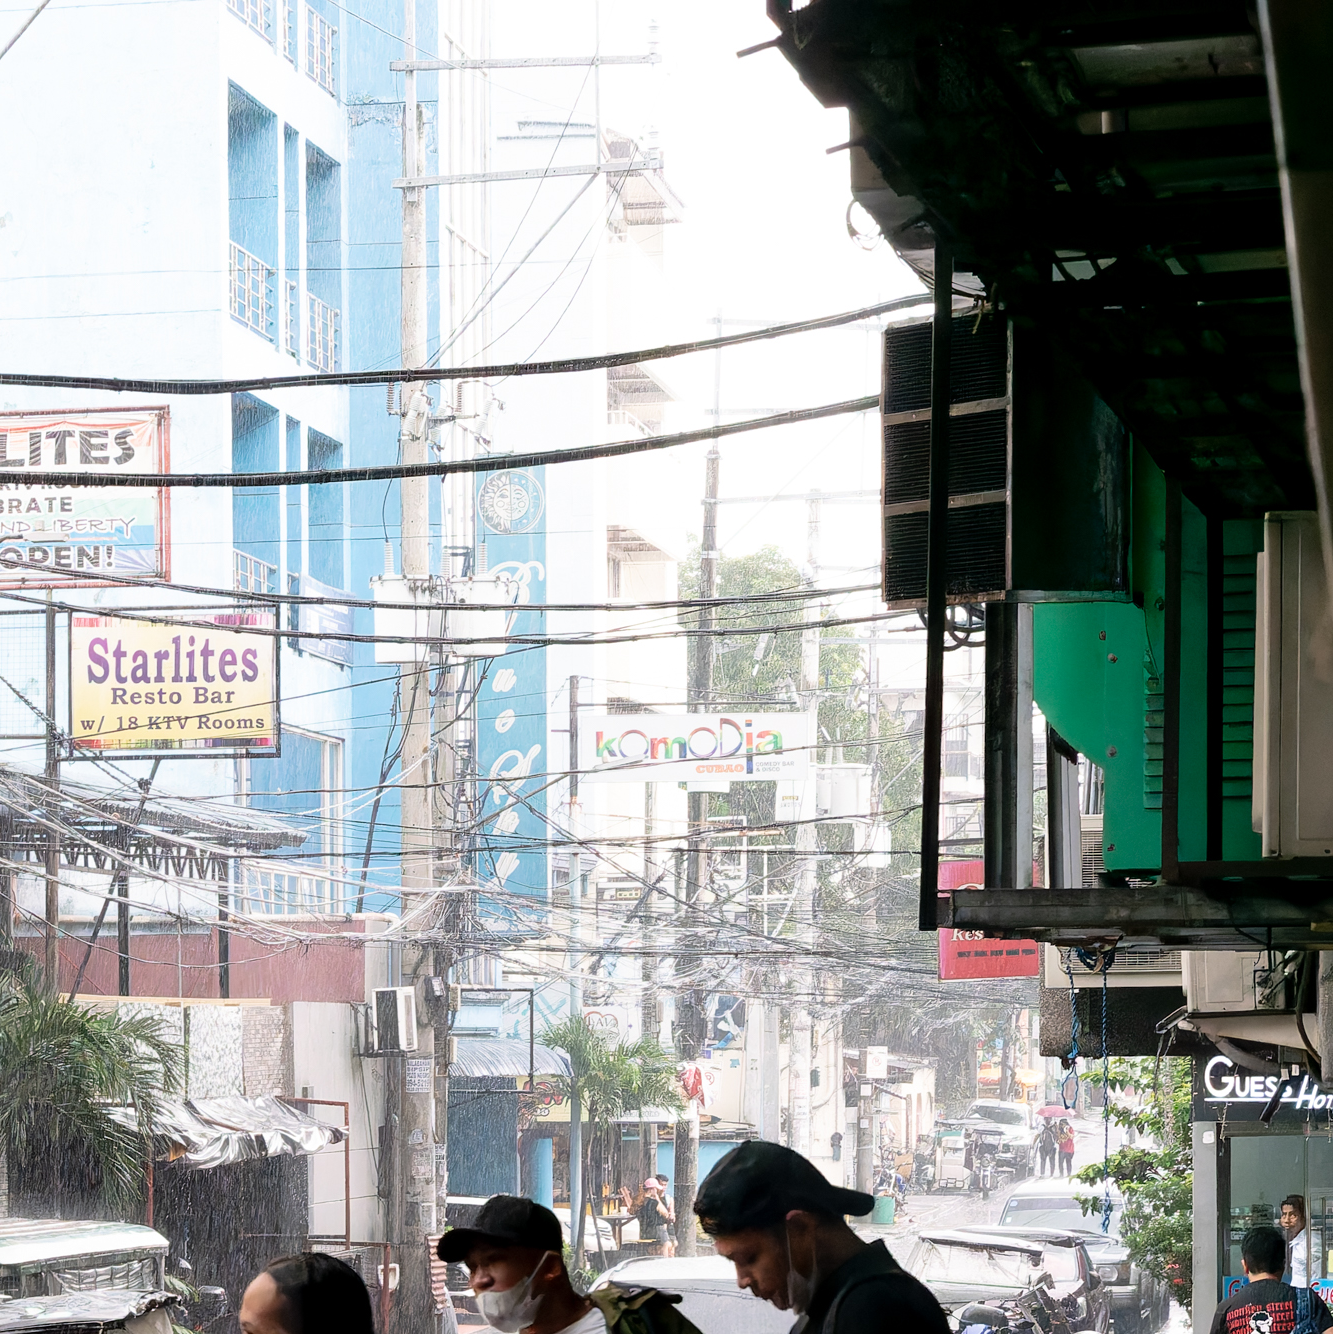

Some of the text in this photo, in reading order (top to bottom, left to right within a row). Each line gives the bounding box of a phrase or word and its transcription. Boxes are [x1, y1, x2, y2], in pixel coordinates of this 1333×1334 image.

[37, 516, 136, 538] IBERTY
[87, 635, 259, 684] Starlites
[111, 687, 235, 705] Resto Bar
[81, 715, 265, 732] w/ 18 KTV Rooms
[696, 764, 744, 774] CUBAO
